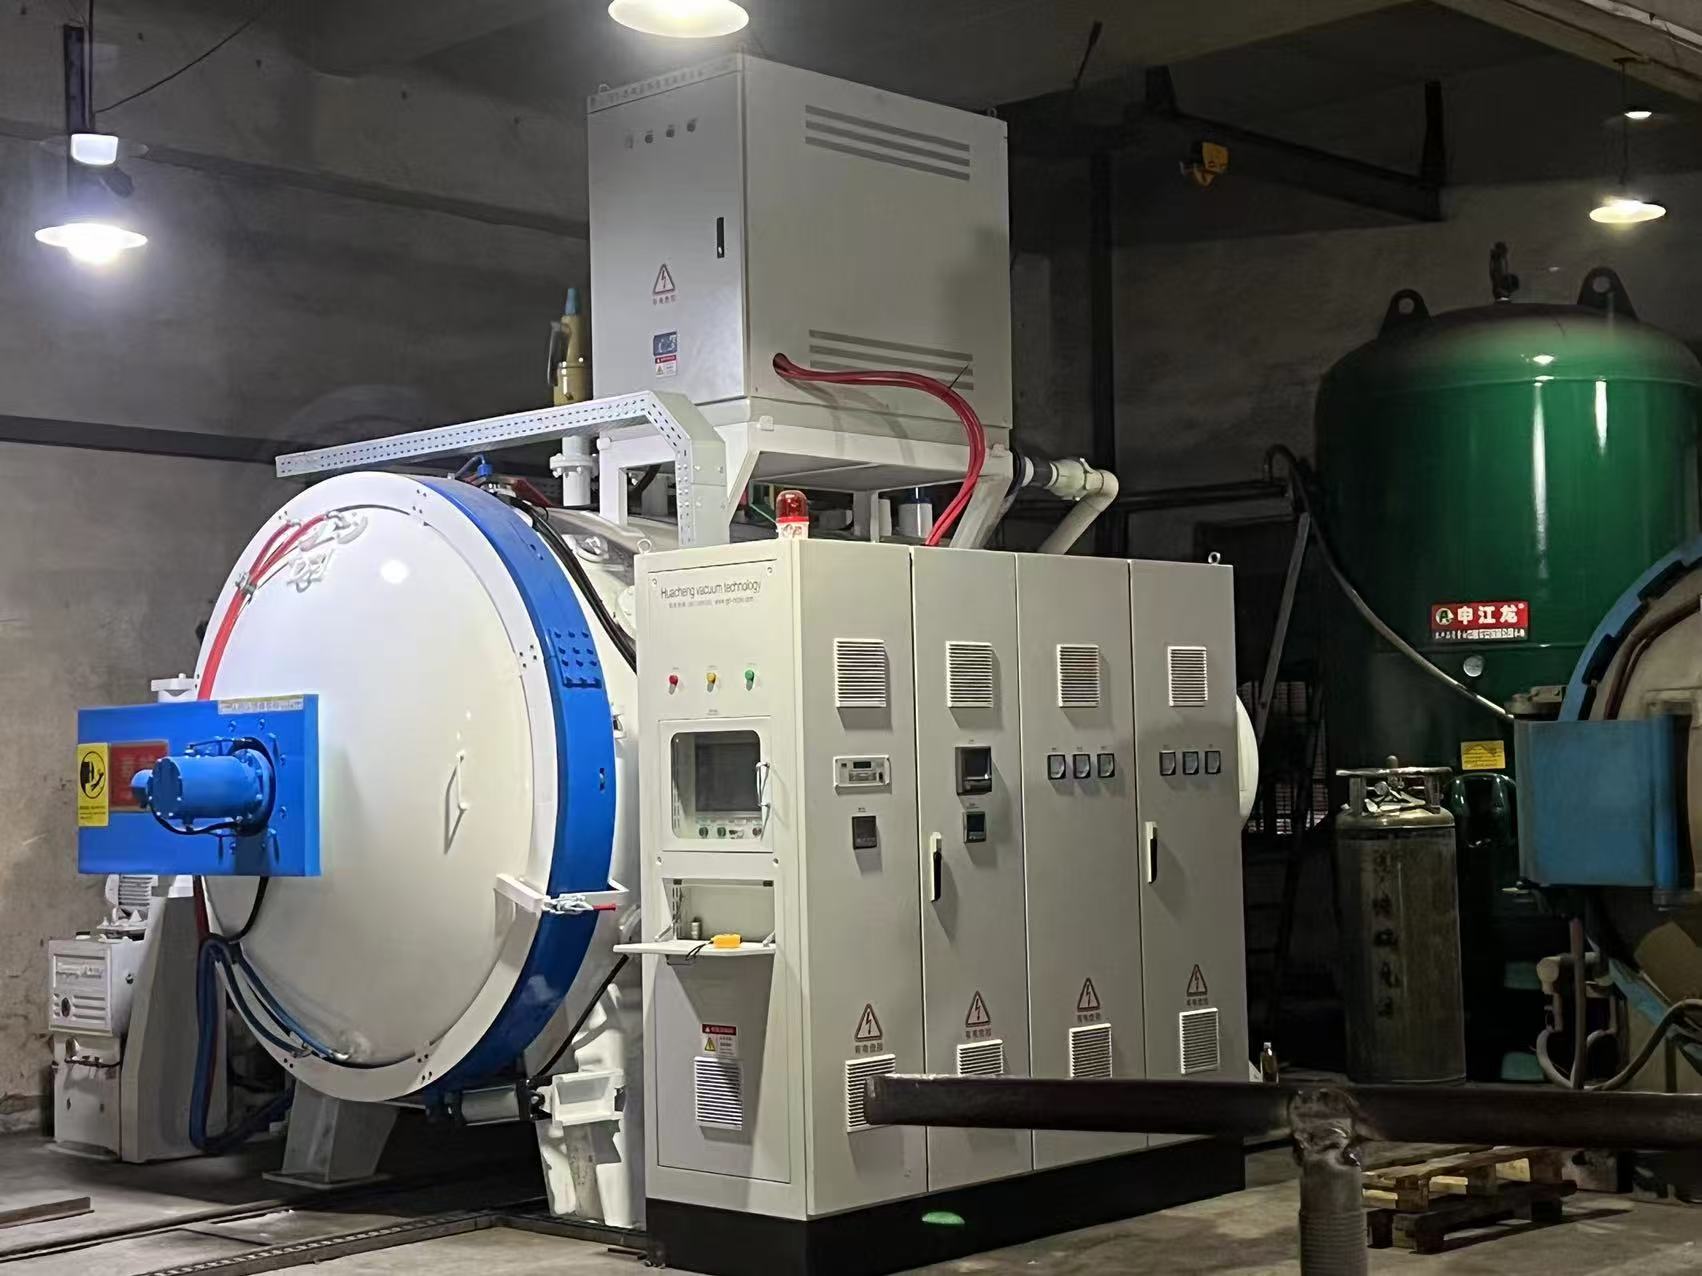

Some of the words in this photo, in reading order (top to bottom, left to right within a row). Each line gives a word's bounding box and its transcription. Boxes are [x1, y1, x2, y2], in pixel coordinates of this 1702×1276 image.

[661, 585, 695, 599] Huacheng
[697, 584, 722, 596] vacuum
[724, 579, 761, 594] technology
[1457, 604, 1518, 625] 申江龙
